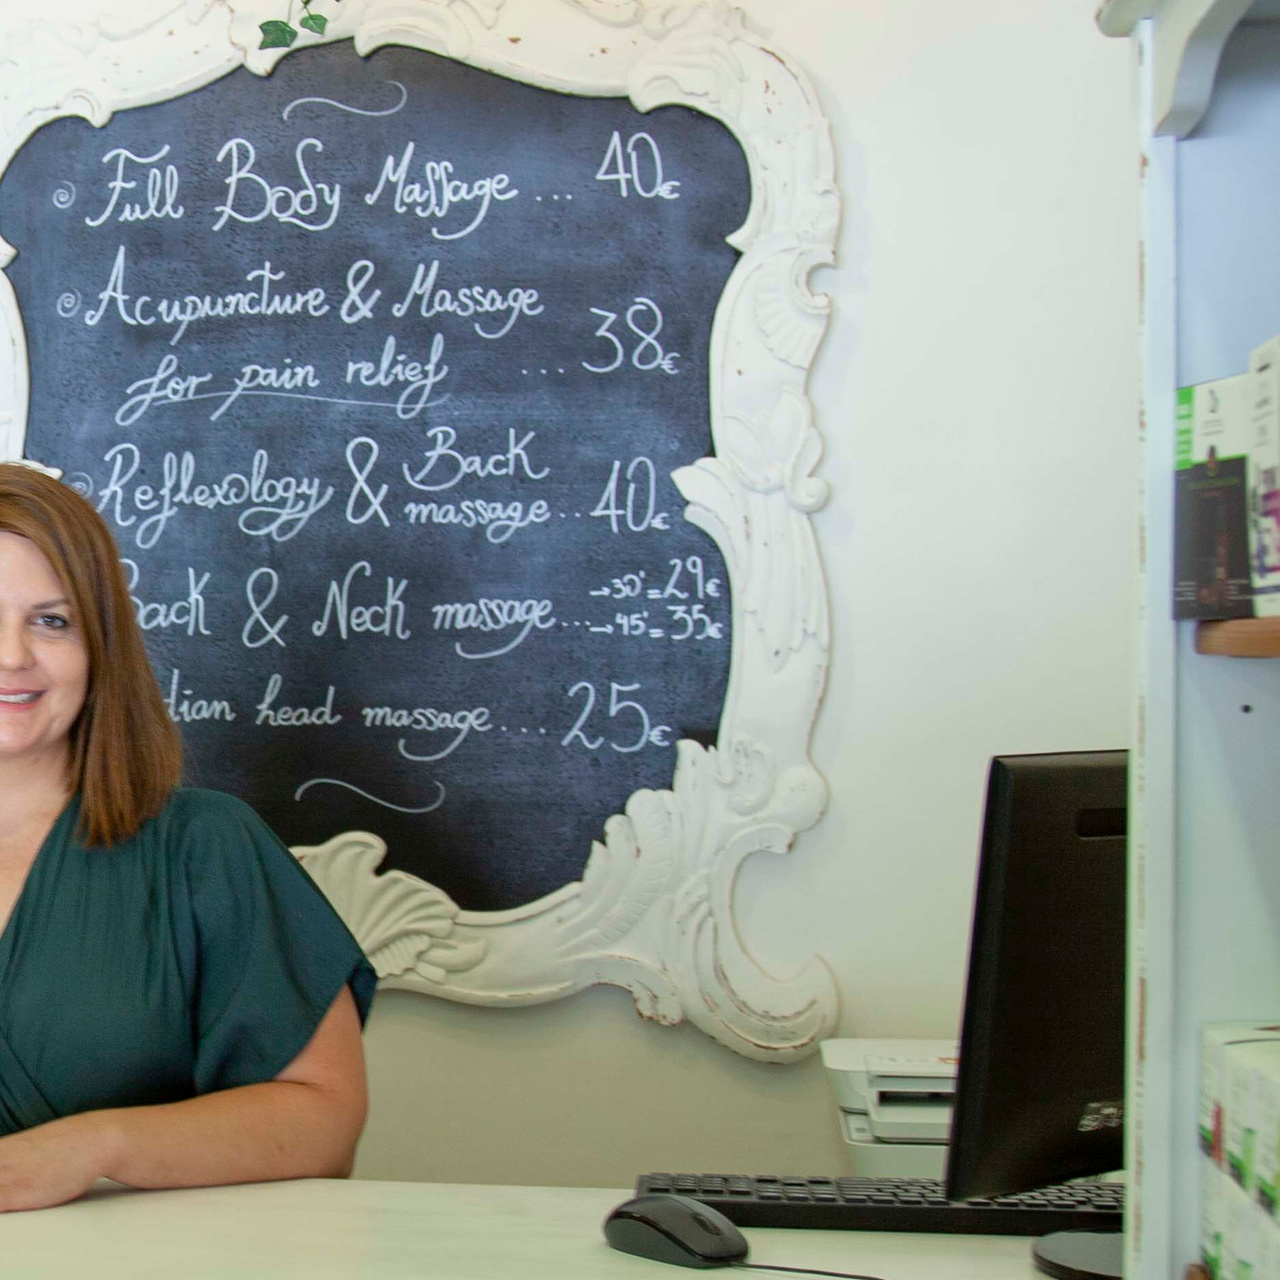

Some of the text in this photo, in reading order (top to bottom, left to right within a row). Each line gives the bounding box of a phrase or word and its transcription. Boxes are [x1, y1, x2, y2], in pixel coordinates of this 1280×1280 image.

[85, 144, 184, 227] Full
[213, 138, 341, 231] Body
[366, 141, 519, 240] Massage
[85, 245, 544, 346] Acupuncture & Massage
[115, 333, 450, 425] for pain relief
[97, 427, 550, 549] Reflexology & Back
[405, 500, 551, 543] massage
[242, 567, 286, 648] &
[313, 561, 411, 640] Neck
[433, 596, 556, 659] massage
[255, 673, 342, 727] head
[363, 702, 494, 762] massage
